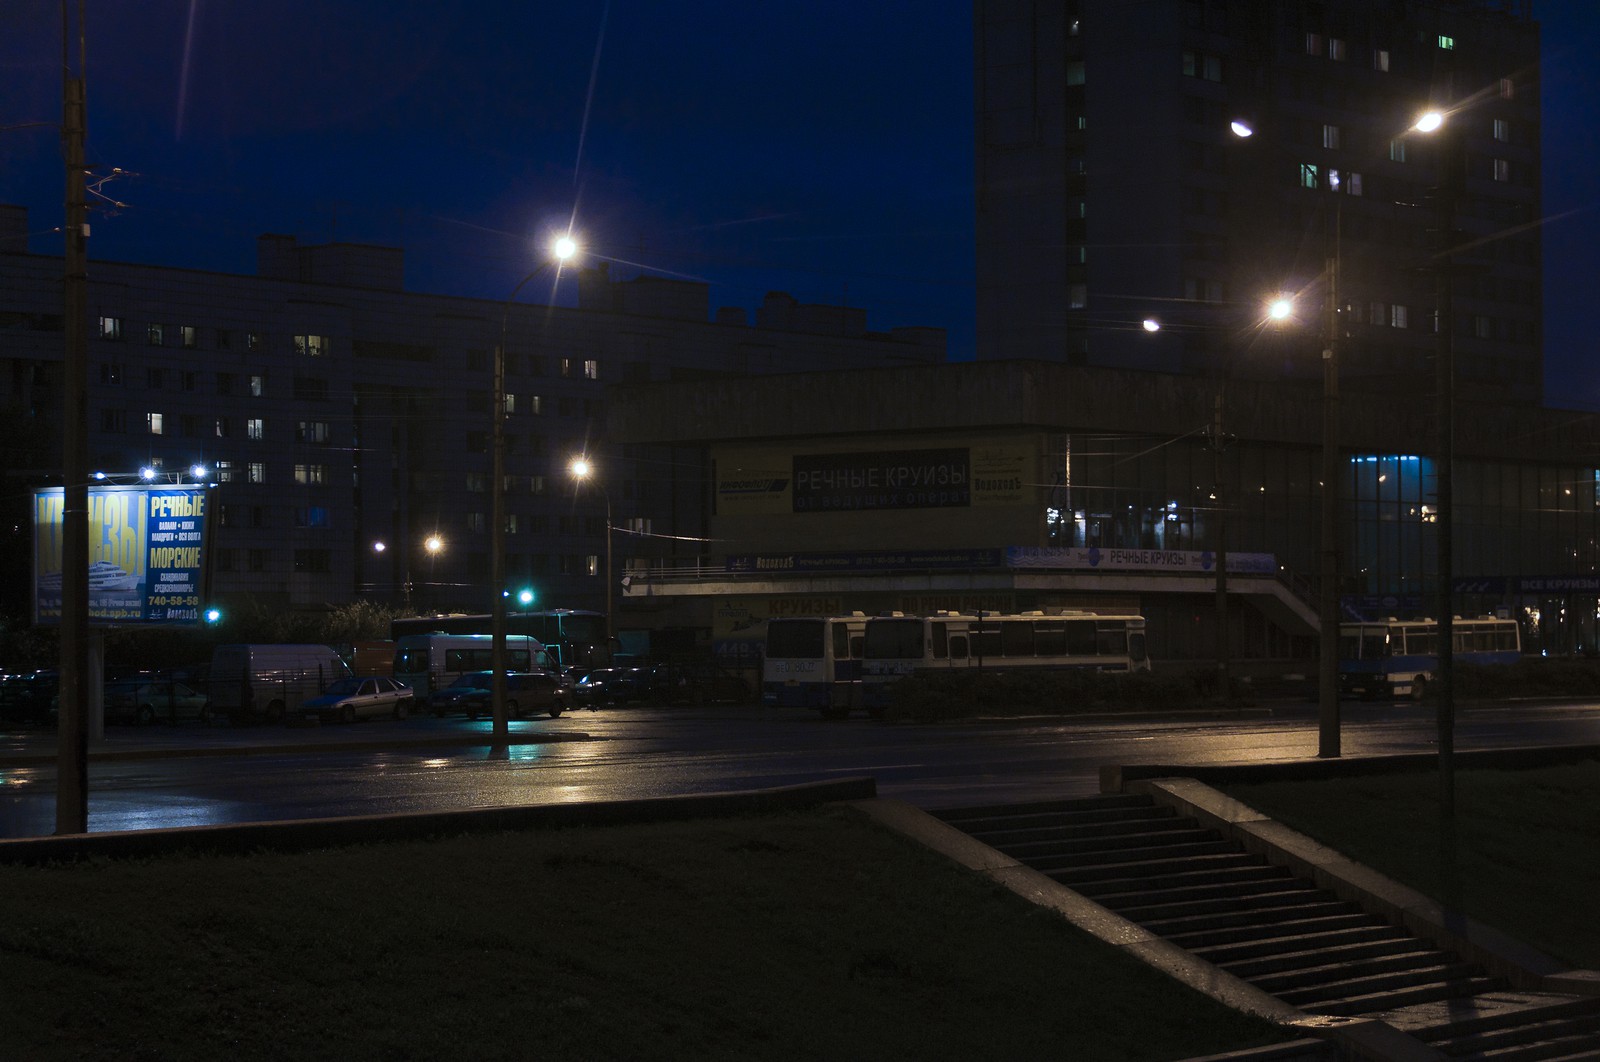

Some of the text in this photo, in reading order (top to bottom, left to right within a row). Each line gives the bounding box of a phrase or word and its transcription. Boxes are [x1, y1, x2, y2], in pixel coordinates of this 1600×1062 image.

[797, 464, 967, 490] РЕЧНЫЕ КРУИЗЫ
[151, 495, 205, 518] РЕЧНЫЕ
[797, 496, 817, 508] от
[821, 493, 898, 509] ведущих
[38, 495, 147, 577] КИЗЫ
[150, 547, 201, 569] МОРСКИЕ
[1110, 550, 1149, 564] РЕЧНЫЕ
[1150, 551, 1187, 565] КРУИЗЫ
[1520, 578, 1600, 590] ВСЕ КРУИЗЫ
[148, 596, 199, 606] 740-58-58
[768, 598, 840, 615] КРУИЗЫ
